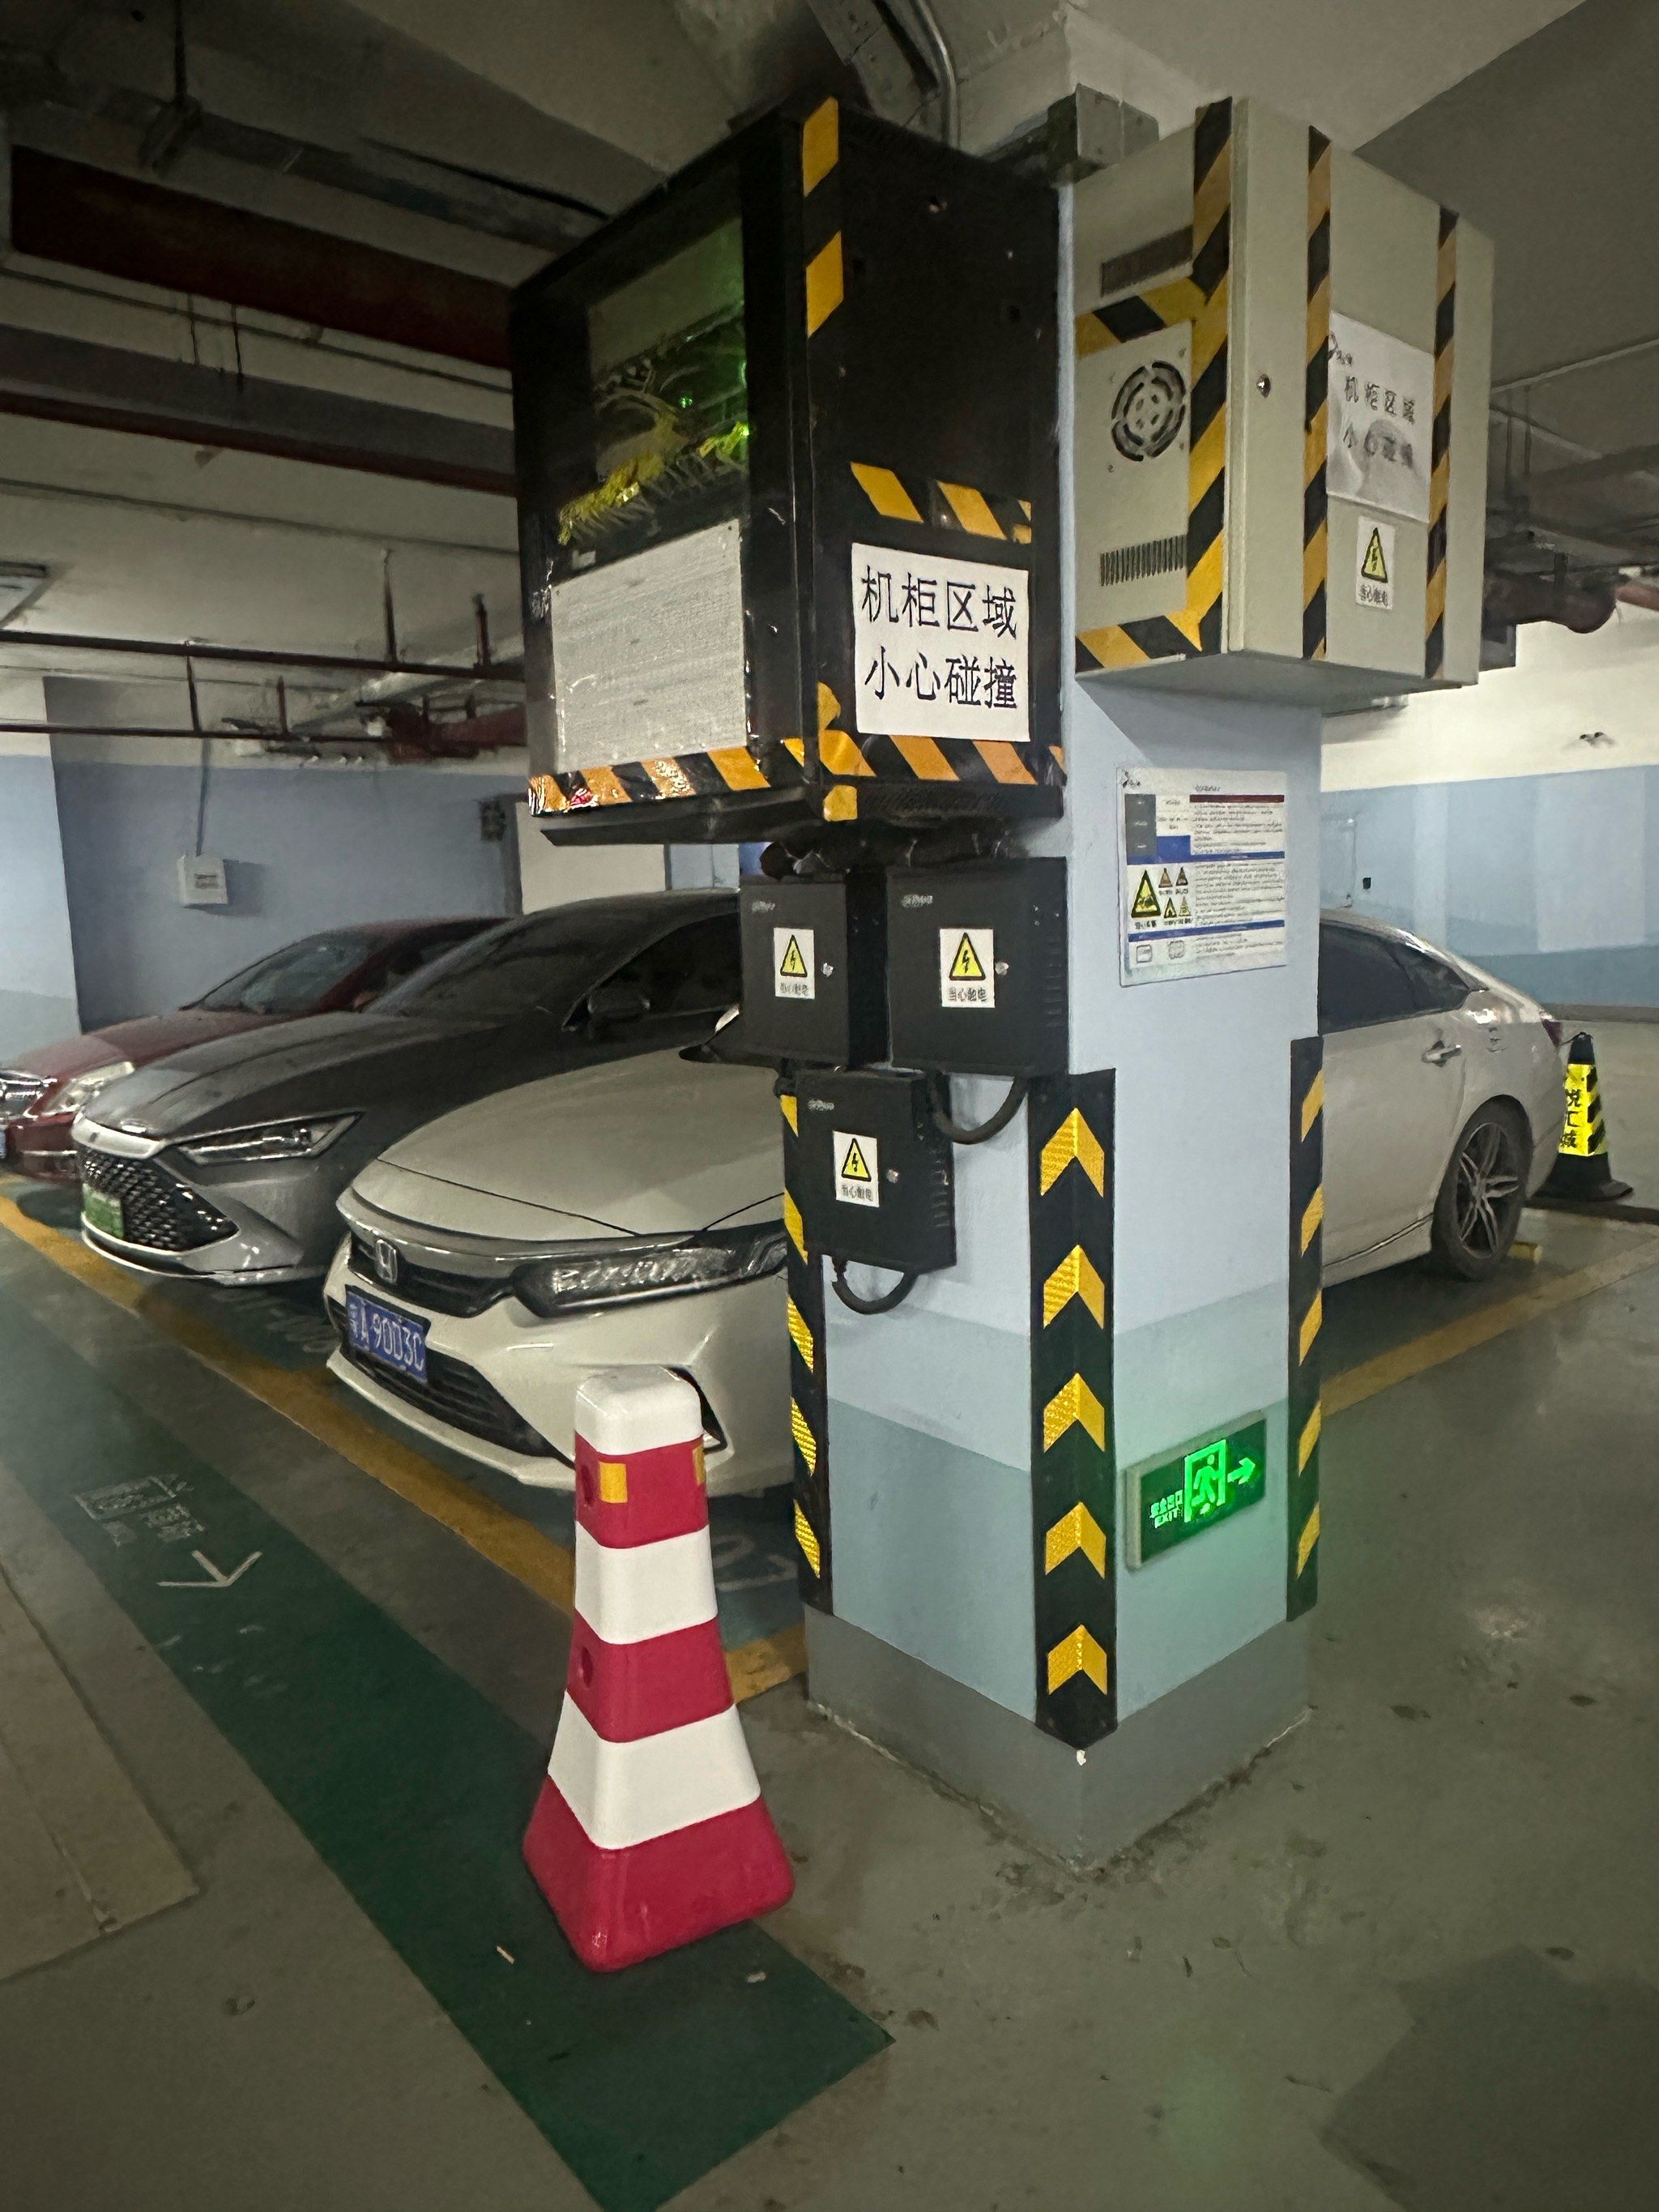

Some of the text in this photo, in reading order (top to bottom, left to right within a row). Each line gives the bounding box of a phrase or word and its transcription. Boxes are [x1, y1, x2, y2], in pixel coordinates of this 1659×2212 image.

[861, 565, 1017, 640] 机柜区域
[864, 646, 1017, 709] 小心碰撞
[1154, 1507, 1179, 1529] EXIT
